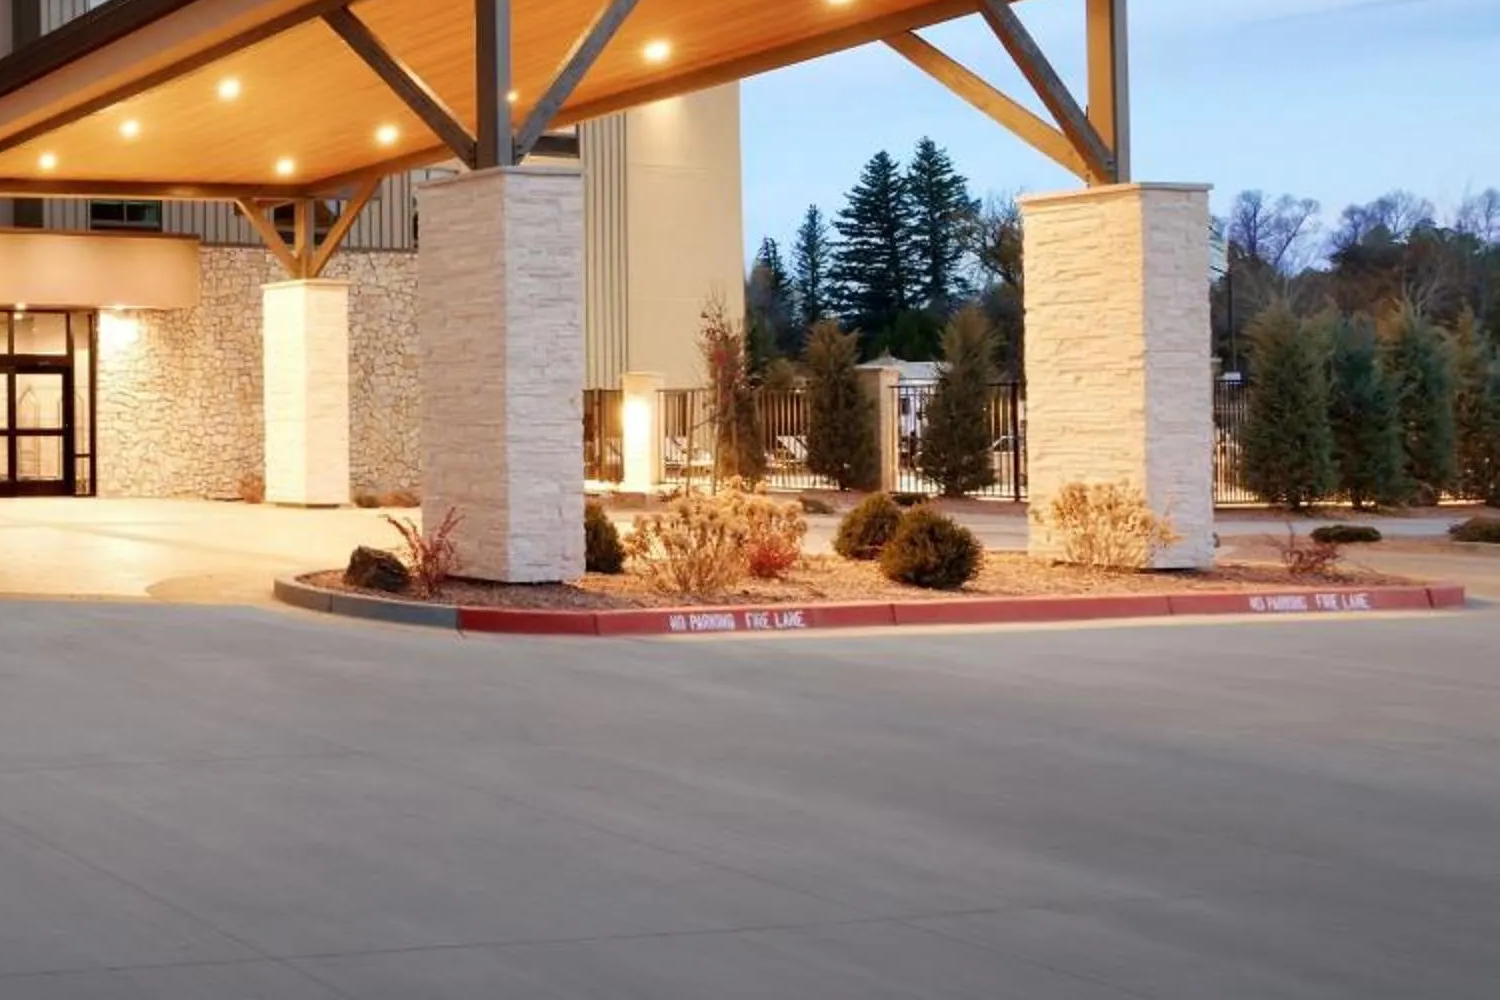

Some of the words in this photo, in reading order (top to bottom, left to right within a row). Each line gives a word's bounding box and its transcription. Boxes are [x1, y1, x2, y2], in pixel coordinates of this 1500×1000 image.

[669, 614, 687, 631] NO
[745, 612, 770, 628] FIRE
[773, 610, 806, 628] LANE
